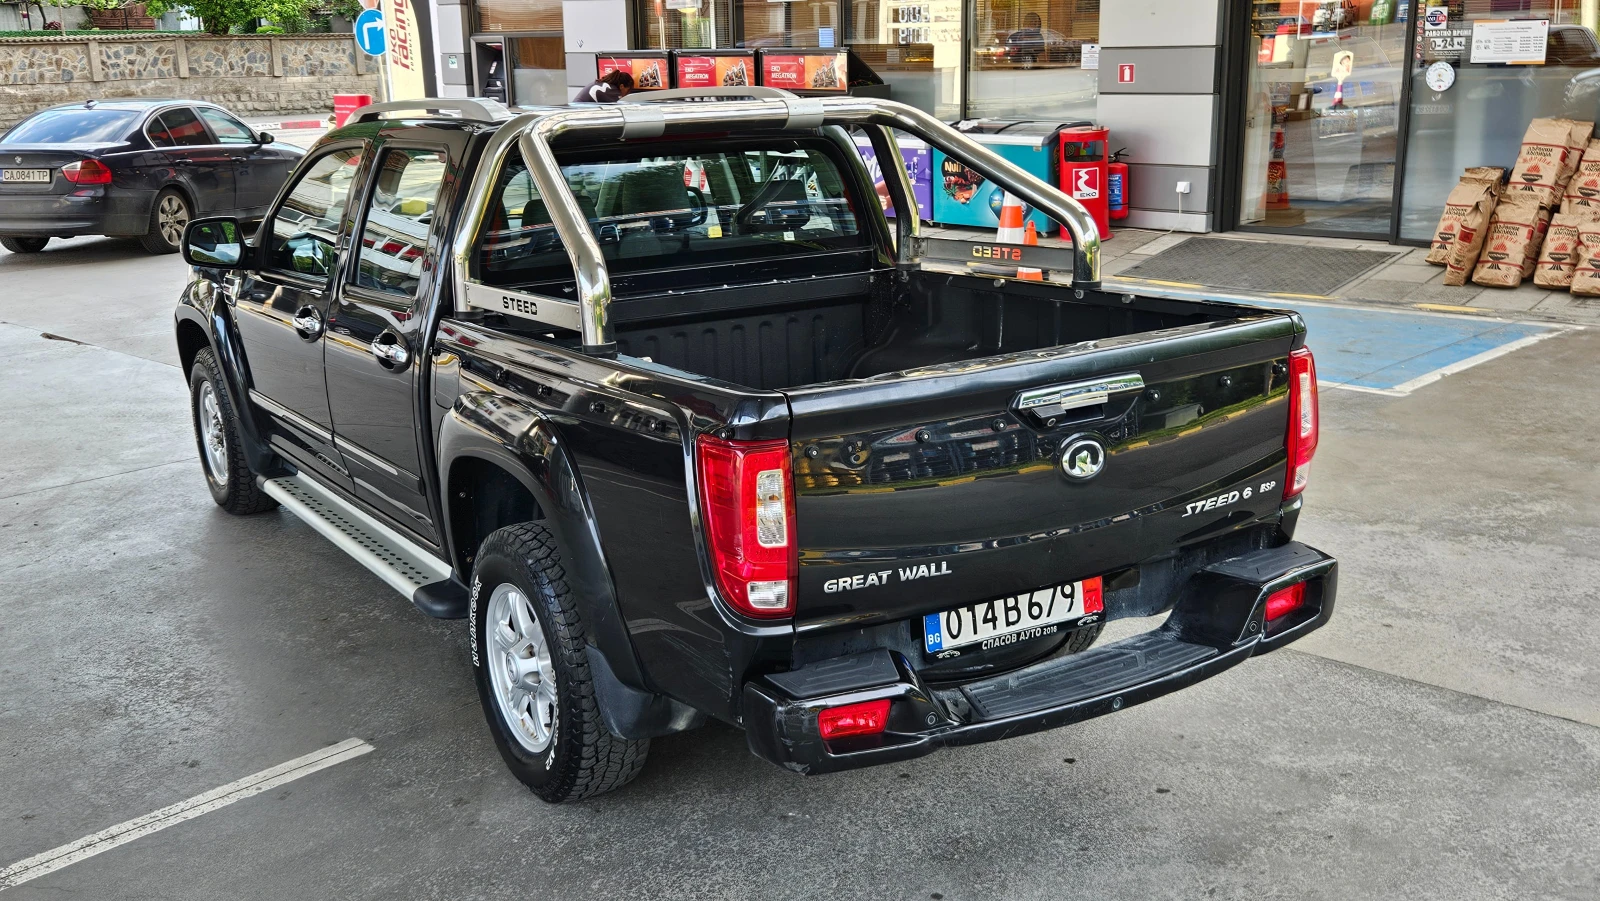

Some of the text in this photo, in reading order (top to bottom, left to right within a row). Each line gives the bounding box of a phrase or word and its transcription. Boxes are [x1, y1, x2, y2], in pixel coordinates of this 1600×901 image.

[502, 296, 538, 316] STEED
[1183, 481, 1277, 518] STEED 6 ESP
[824, 562, 953, 594] GREAT WALL
[928, 633, 941, 646] BG
[982, 634, 1017, 651] СПАСОВ
[1020, 627, 1042, 642] АУТО
